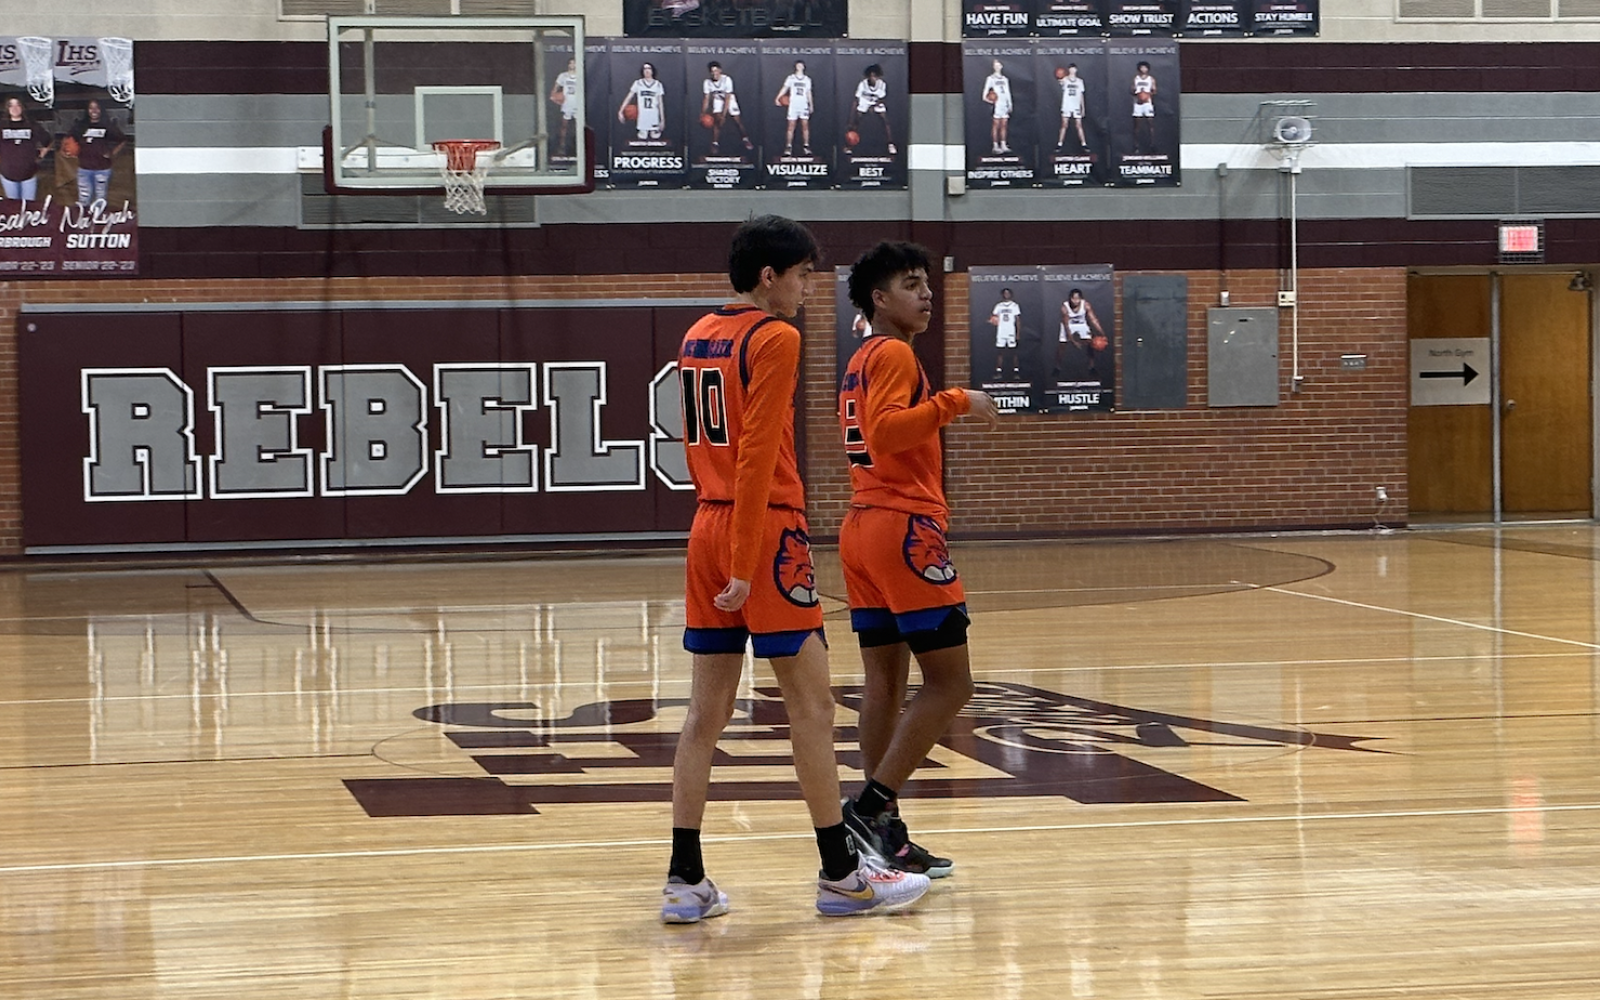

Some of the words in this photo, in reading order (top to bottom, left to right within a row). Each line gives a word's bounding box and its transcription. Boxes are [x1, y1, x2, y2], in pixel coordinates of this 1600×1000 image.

[966, 13, 1000, 25] HAVE
[1003, 13, 1028, 25] FUN
[1036, 18, 1076, 27] ULTIMATE
[1078, 18, 1102, 27] GOAL
[1109, 14, 1141, 24] SHOW
[1143, 14, 1174, 23] TRUST
[1187, 13, 1238, 24] ACTIONS
[1255, 13, 1278, 22] STAY
[1279, 13, 1313, 22] HUMBLE
[55, 40, 98, 67] LHS
[613, 156, 683, 169] PROGRESS
[707, 168, 739, 177] SHARED
[766, 164, 828, 176] VISUALIZE
[858, 167, 884, 177] BEST
[1054, 163, 1092, 175] HEART
[1119, 165, 1173, 175] TEAMMATE
[705, 175, 740, 184] VICTORY
[967, 170, 999, 179] INSPIRE
[1000, 170, 1034, 179] OTHERS
[0, 194, 53, 232] sabel
[66, 234, 131, 249] SUTTON
[972, 274, 1000, 283] BELIEVE
[1001, 274, 1008, 283] &
[1008, 274, 1039, 283] ACHIEVE
[1044, 273, 1072, 282] BELIEVE
[1073, 273, 1080, 282] &
[1079, 273, 1111, 282] ACHIEVE
[994, 396, 1030, 408] ITHIN
[1058, 394, 1100, 404] HUSTLE
[680, 366, 730, 447] 10
